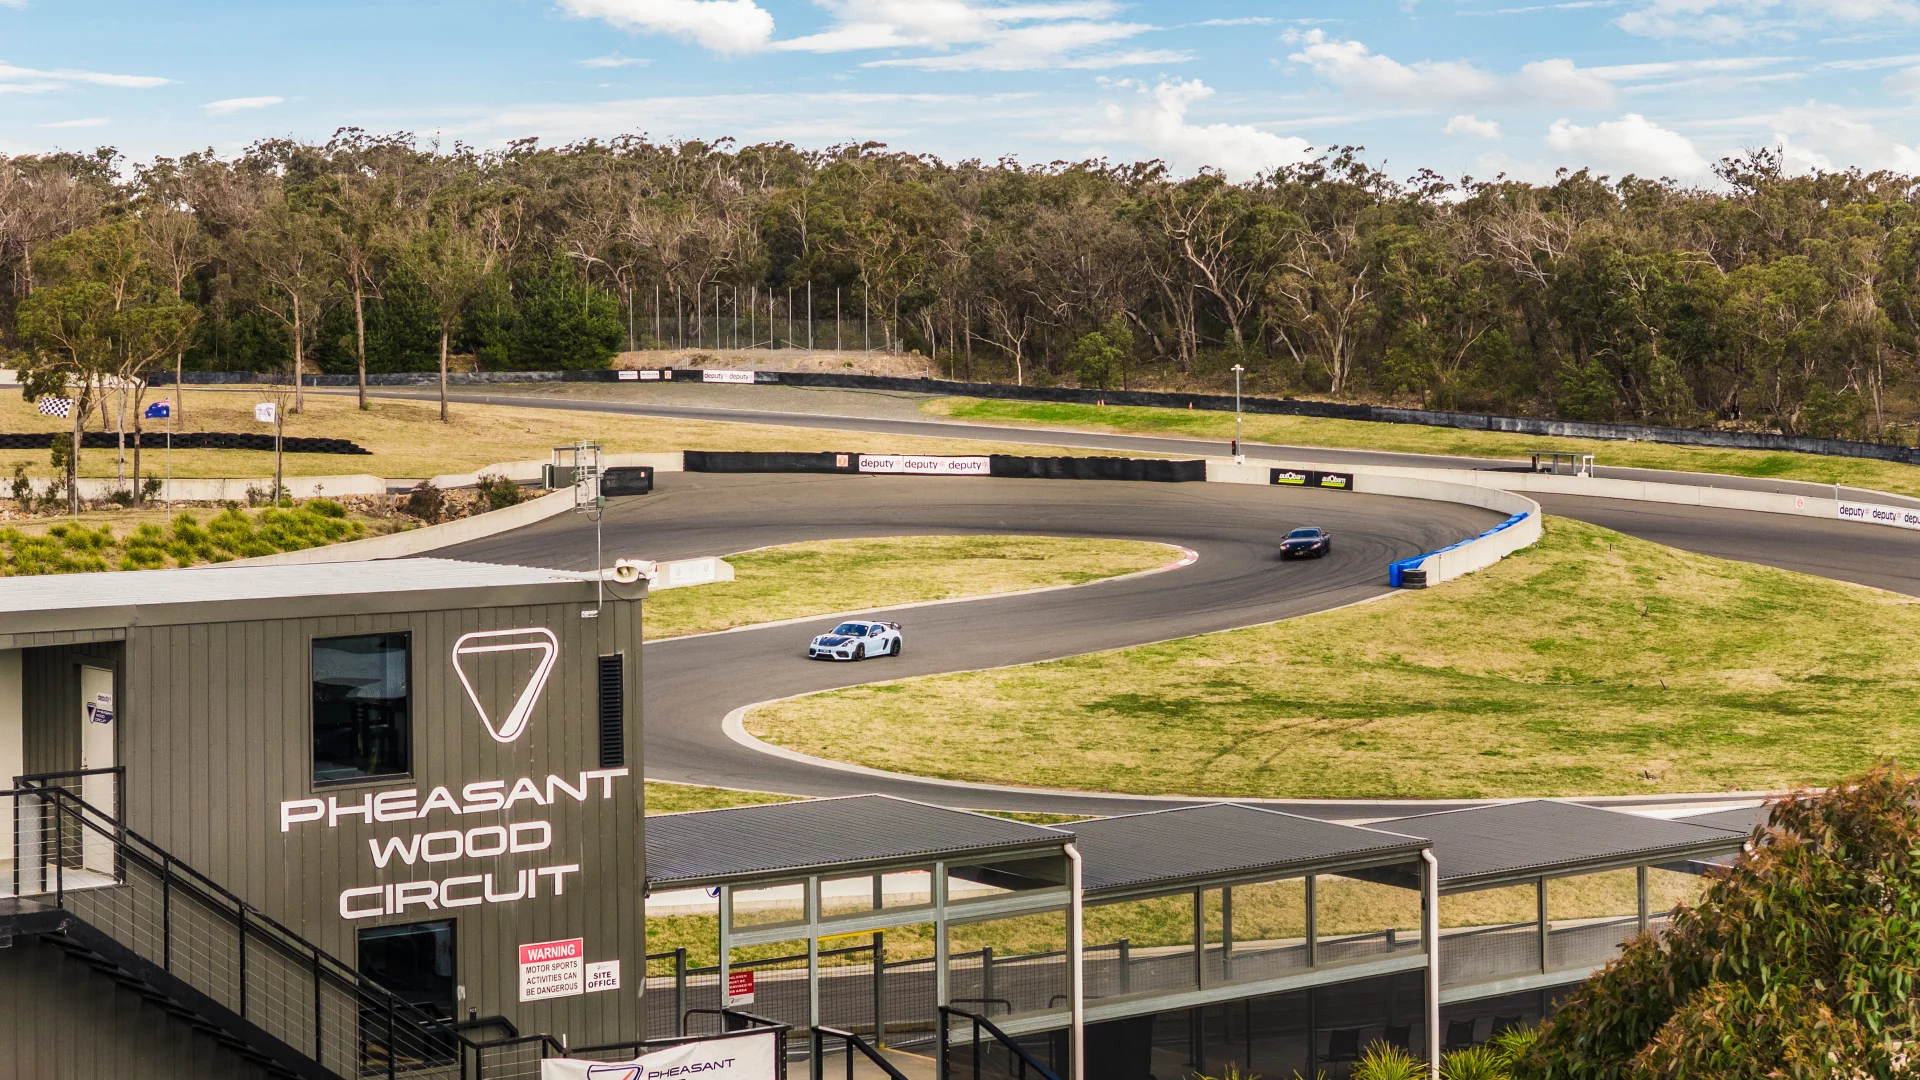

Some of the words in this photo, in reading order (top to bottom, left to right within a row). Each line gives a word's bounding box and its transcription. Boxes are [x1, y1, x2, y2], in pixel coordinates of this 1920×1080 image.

[861, 459, 895, 469] deputy
[904, 459, 938, 470] deputy
[948, 460, 982, 470] deputy
[1839, 505, 1865, 518] deputy
[1872, 508, 1896, 522] deputy
[281, 768, 629, 833] PHEASANT
[368, 820, 552, 869] WOOD
[339, 864, 579, 919] CIRCUIT
[527, 943, 576, 961] WARNING
[526, 964, 550, 974] MOTOR
[551, 961, 578, 971] SPORTS
[526, 973, 562, 985] ACTIVITIES
[563, 972, 577, 980] CAN
[588, 978, 617, 988] OFFICE
[593, 971, 612, 980] SITE
[526, 987, 535, 996] BE
[537, 982, 578, 995] DANGEROUS
[648, 1058, 736, 1080] PHEASANT
